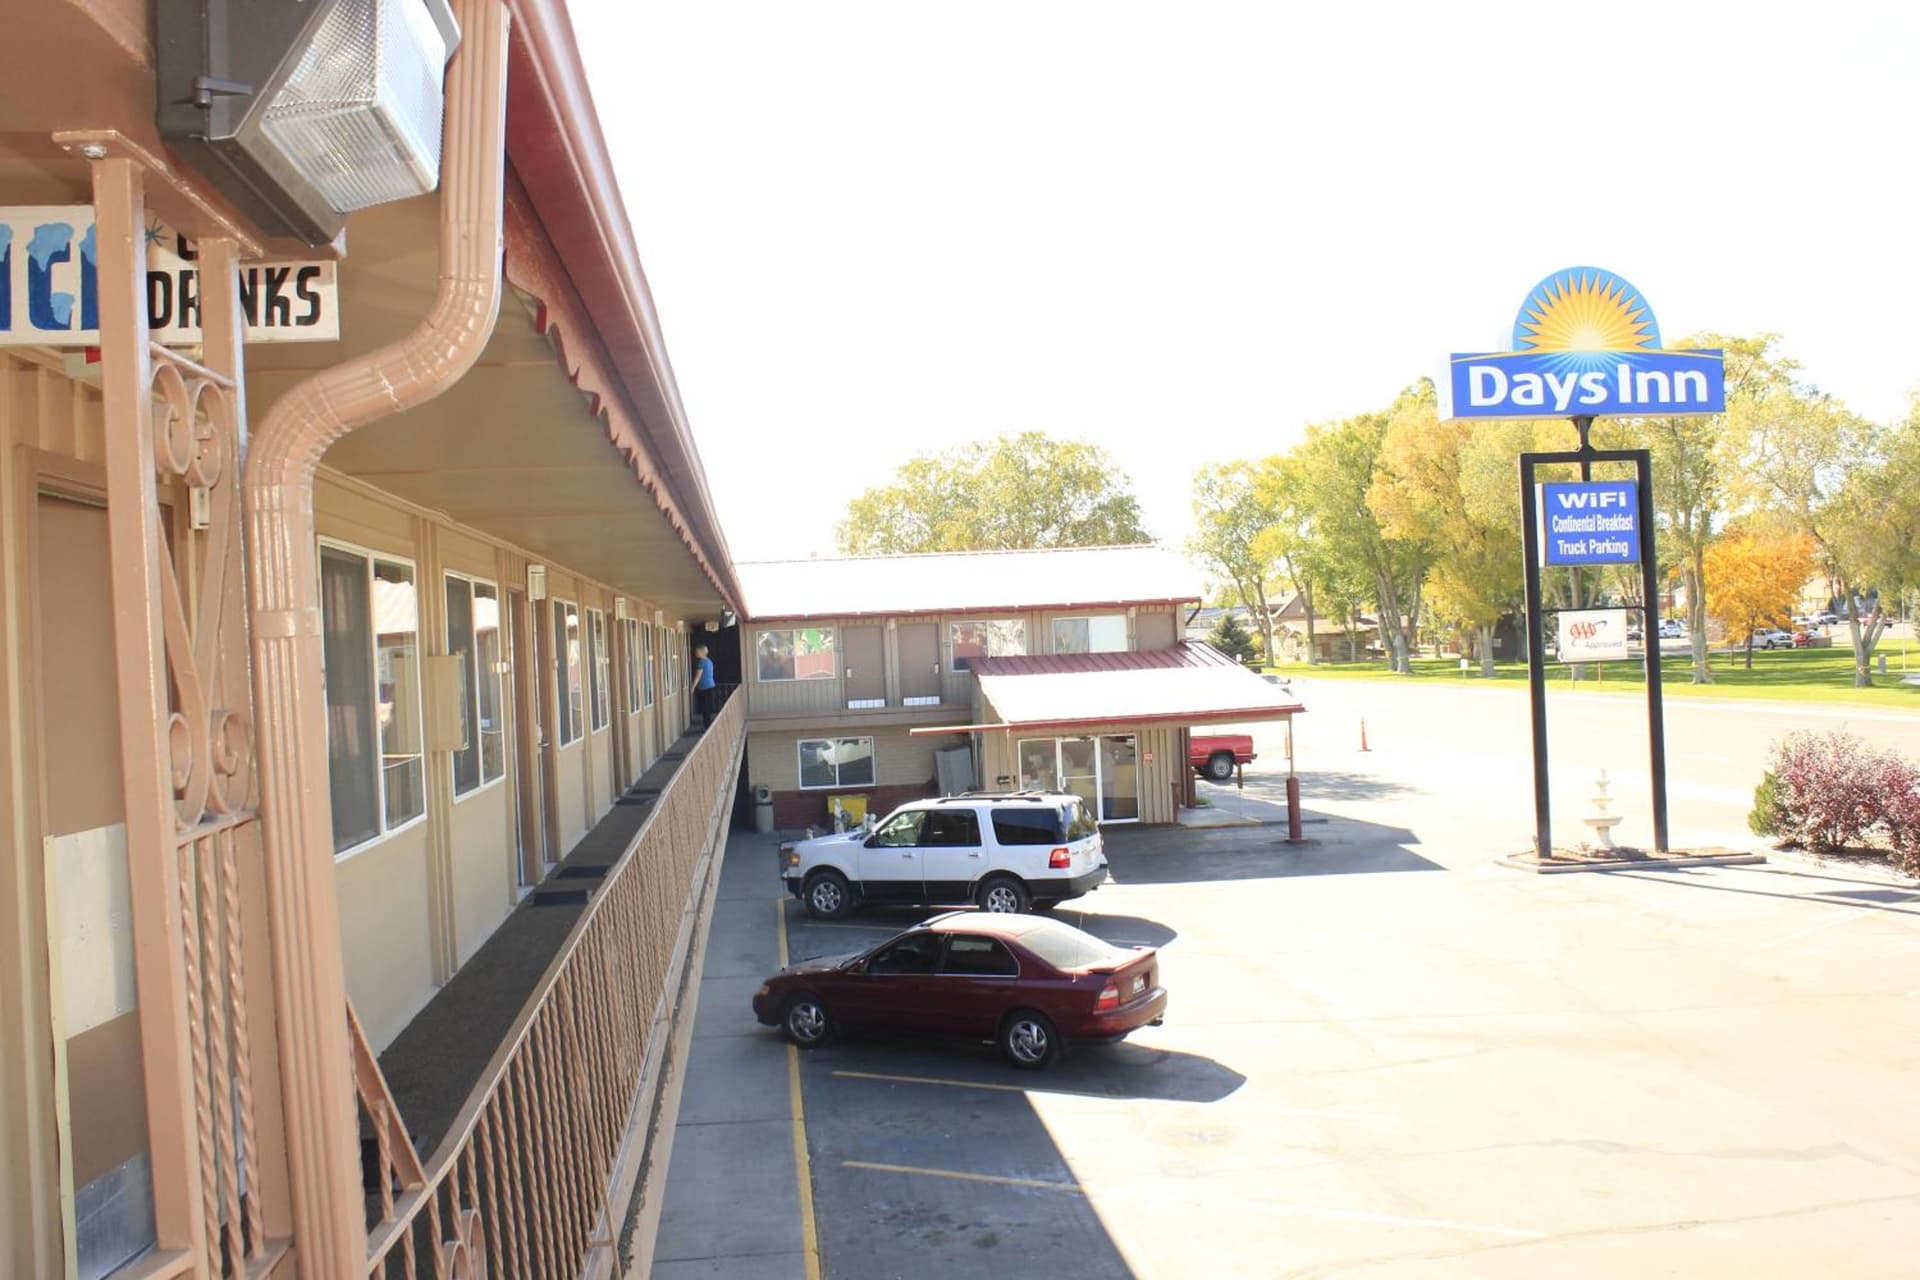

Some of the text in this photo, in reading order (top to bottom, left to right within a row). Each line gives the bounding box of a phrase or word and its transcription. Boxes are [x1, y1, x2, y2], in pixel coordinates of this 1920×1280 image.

[146, 265, 321, 330] DRNKS
[1469, 364, 1707, 411] Days Inn
[1552, 513, 1634, 533] Continental Breakfast
[1557, 536, 1629, 557] Truck Parking
